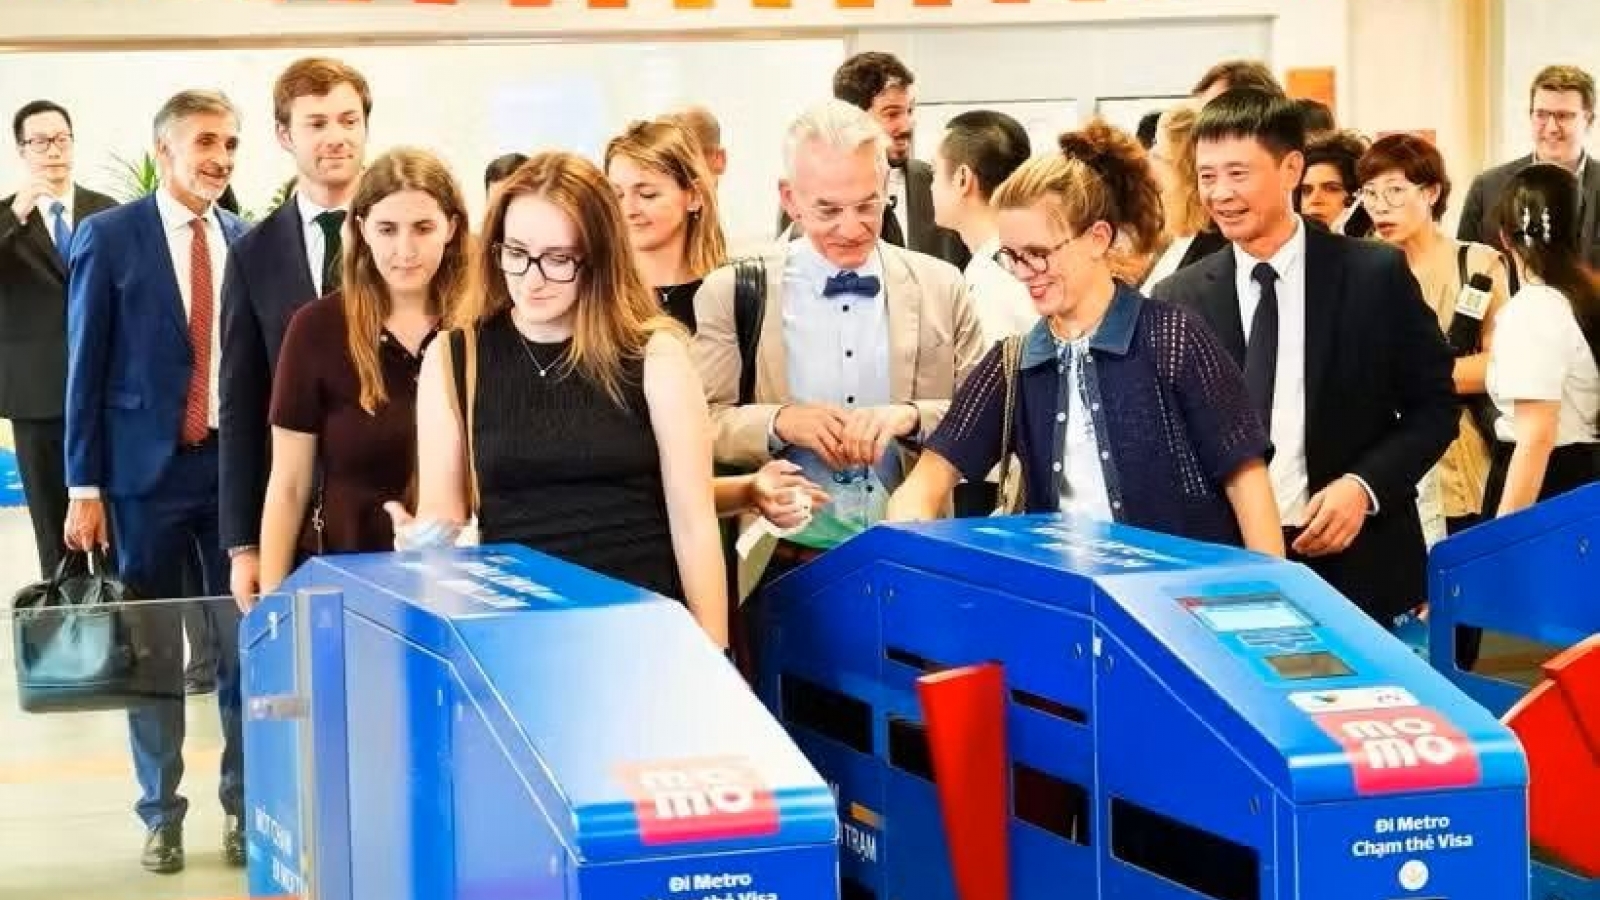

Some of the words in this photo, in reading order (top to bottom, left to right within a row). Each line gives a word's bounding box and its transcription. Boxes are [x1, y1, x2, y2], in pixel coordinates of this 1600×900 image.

[1375, 818, 1394, 833] Đi
[1397, 815, 1450, 831] Metro
[1352, 839, 1402, 858] Chạm
[1438, 832, 1473, 848] Visa
[693, 872, 752, 890] Metro
